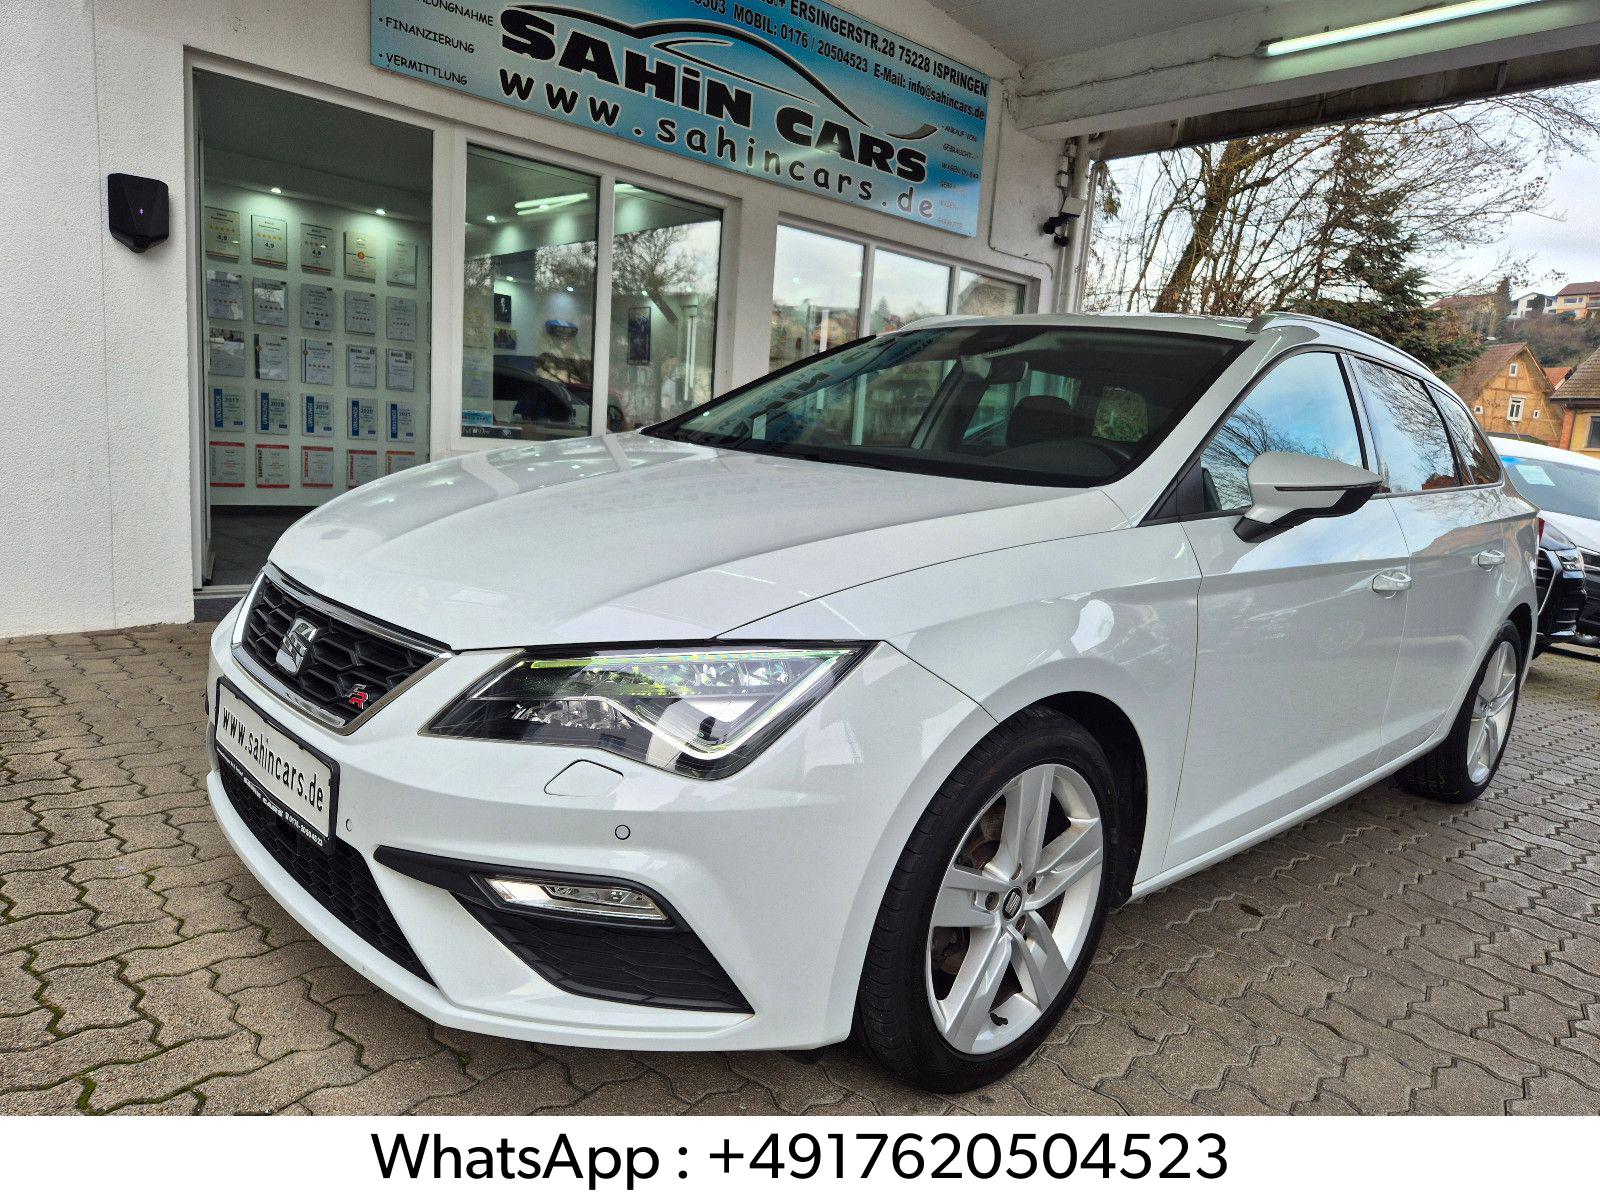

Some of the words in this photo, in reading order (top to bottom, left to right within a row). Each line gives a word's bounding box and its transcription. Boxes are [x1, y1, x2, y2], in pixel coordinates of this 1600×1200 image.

[385, 17, 475, 54] FINANZIERUNG
[386, 52, 468, 85] VERMITTLUNG
[733, 4, 777, 35] MOBIL:
[780, 23, 809, 49] 0176
[816, 39, 869, 73] 20504523
[873, 62, 907, 89] E-Mail:
[908, 77, 985, 121] info@sahincars.de
[790, 0, 895, 58] ERSINGERSTR.28
[898, 44, 931, 73] 75228
[933, 60, 989, 97] ISPRINGEN
[499, 68, 934, 219] www.sahincars.de
[776, 106, 927, 184] CARS
[223, 706, 324, 812] www.sahincars.de
